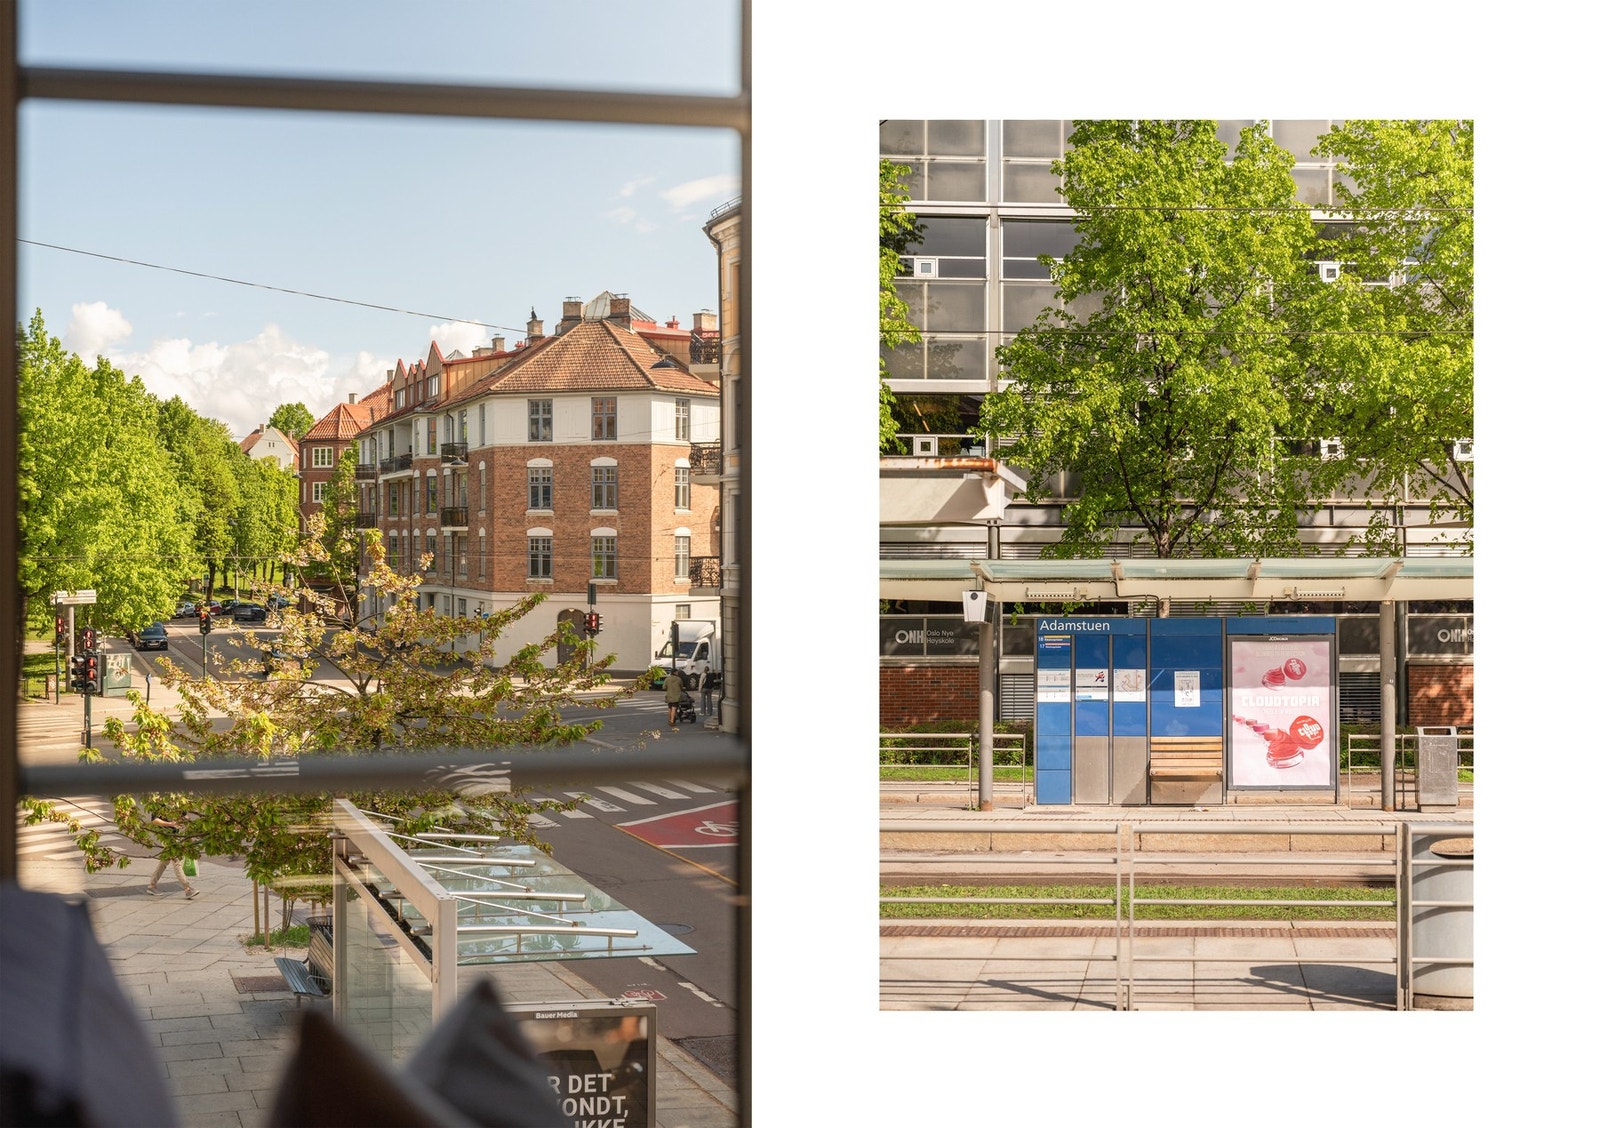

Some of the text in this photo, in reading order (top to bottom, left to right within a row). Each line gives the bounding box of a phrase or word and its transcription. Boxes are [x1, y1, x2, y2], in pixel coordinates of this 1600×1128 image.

[1040, 620, 1110, 631] Adamstuen
[895, 630, 924, 643] ONH
[941, 630, 954, 638] Nye
[1437, 629, 1466, 642] ONH
[1241, 695, 1320, 707] CLOUDTOPIA
[568, 1073, 612, 1093] DET
[557, 1095, 629, 1118] ONDT,
